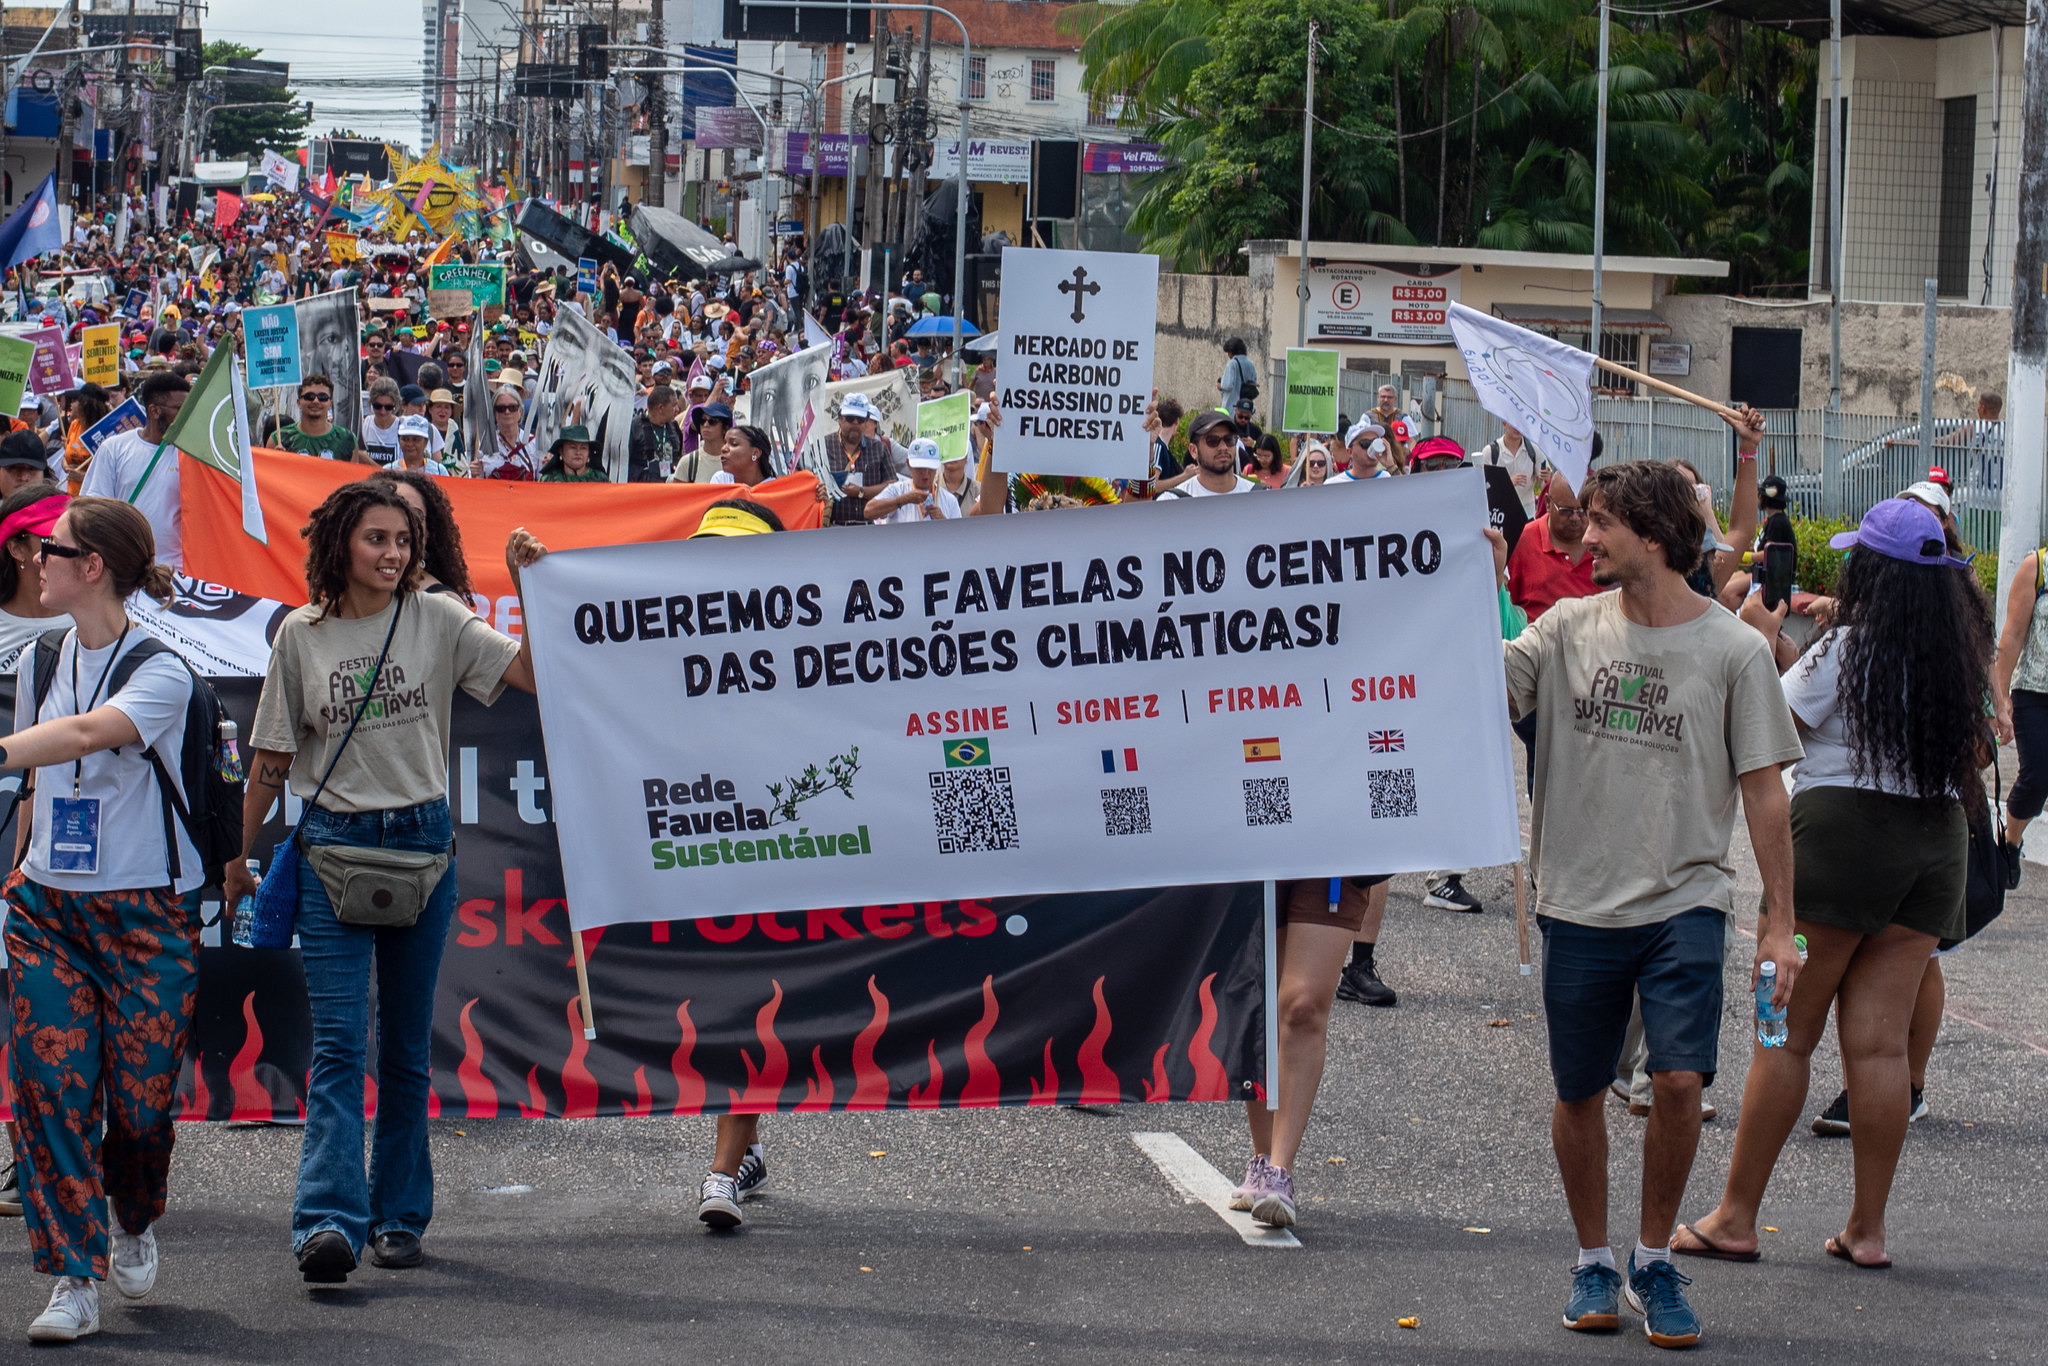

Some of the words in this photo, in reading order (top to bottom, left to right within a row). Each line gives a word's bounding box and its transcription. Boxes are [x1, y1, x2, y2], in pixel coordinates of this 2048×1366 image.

[819, 141, 833, 151] Vel
[835, 141, 849, 151] Fib
[947, 141, 986, 155] JM
[1123, 151, 1138, 161] Vel
[440, 267, 470, 281] GREEN
[471, 269, 491, 281] HELL
[1340, 289, 1352, 304] E
[1417, 290, 1443, 299] 5,00
[261, 313, 279, 329] NÃO
[1416, 312, 1442, 322] 3,00
[263, 345, 282, 359] SEM
[1013, 334, 1107, 359] MERCADO
[1112, 340, 1139, 361] DE
[0, 369, 23, 383] NIZA-TE
[1028, 362, 1121, 387] CARBONO
[1001, 388, 1113, 414] ASSASSINO
[1118, 394, 1145, 415] DE
[1289, 384, 1335, 397] AMAZONIZA-TE
[1019, 416, 1124, 441] FLORESTA
[573, 583, 824, 645] QUEREMOS
[843, 575, 905, 624] AS
[923, 555, 1143, 617] FAVELAS
[1163, 547, 1226, 597] NO
[1245, 529, 1443, 589] CENTRO
[133, 608, 177, 639] agável
[682, 649, 777, 698] DAS
[793, 618, 1019, 688] DECISÕES
[1036, 601, 1342, 668] CLIMÁTICAS!
[339, 653, 394, 673] FESTIVAL
[1609, 660, 1665, 680] FESTIVAL
[1590, 666, 1669, 710] FAVELA
[906, 705, 1010, 737] ASSINE
[1056, 693, 1160, 725] SIGNEZ
[1208, 682, 1303, 714] FIRMA
[1350, 674, 1417, 703] SIGN
[1574, 698, 1684, 742] SUSTENTÁVEL
[1601, 732, 1629, 743] CENTRO
[1629, 738, 1643, 746] DAS
[1643, 741, 1680, 754] SOLUÇÕES
[643, 773, 737, 807] Rede
[647, 802, 769, 839] Favela
[651, 825, 872, 870] Sustentável
